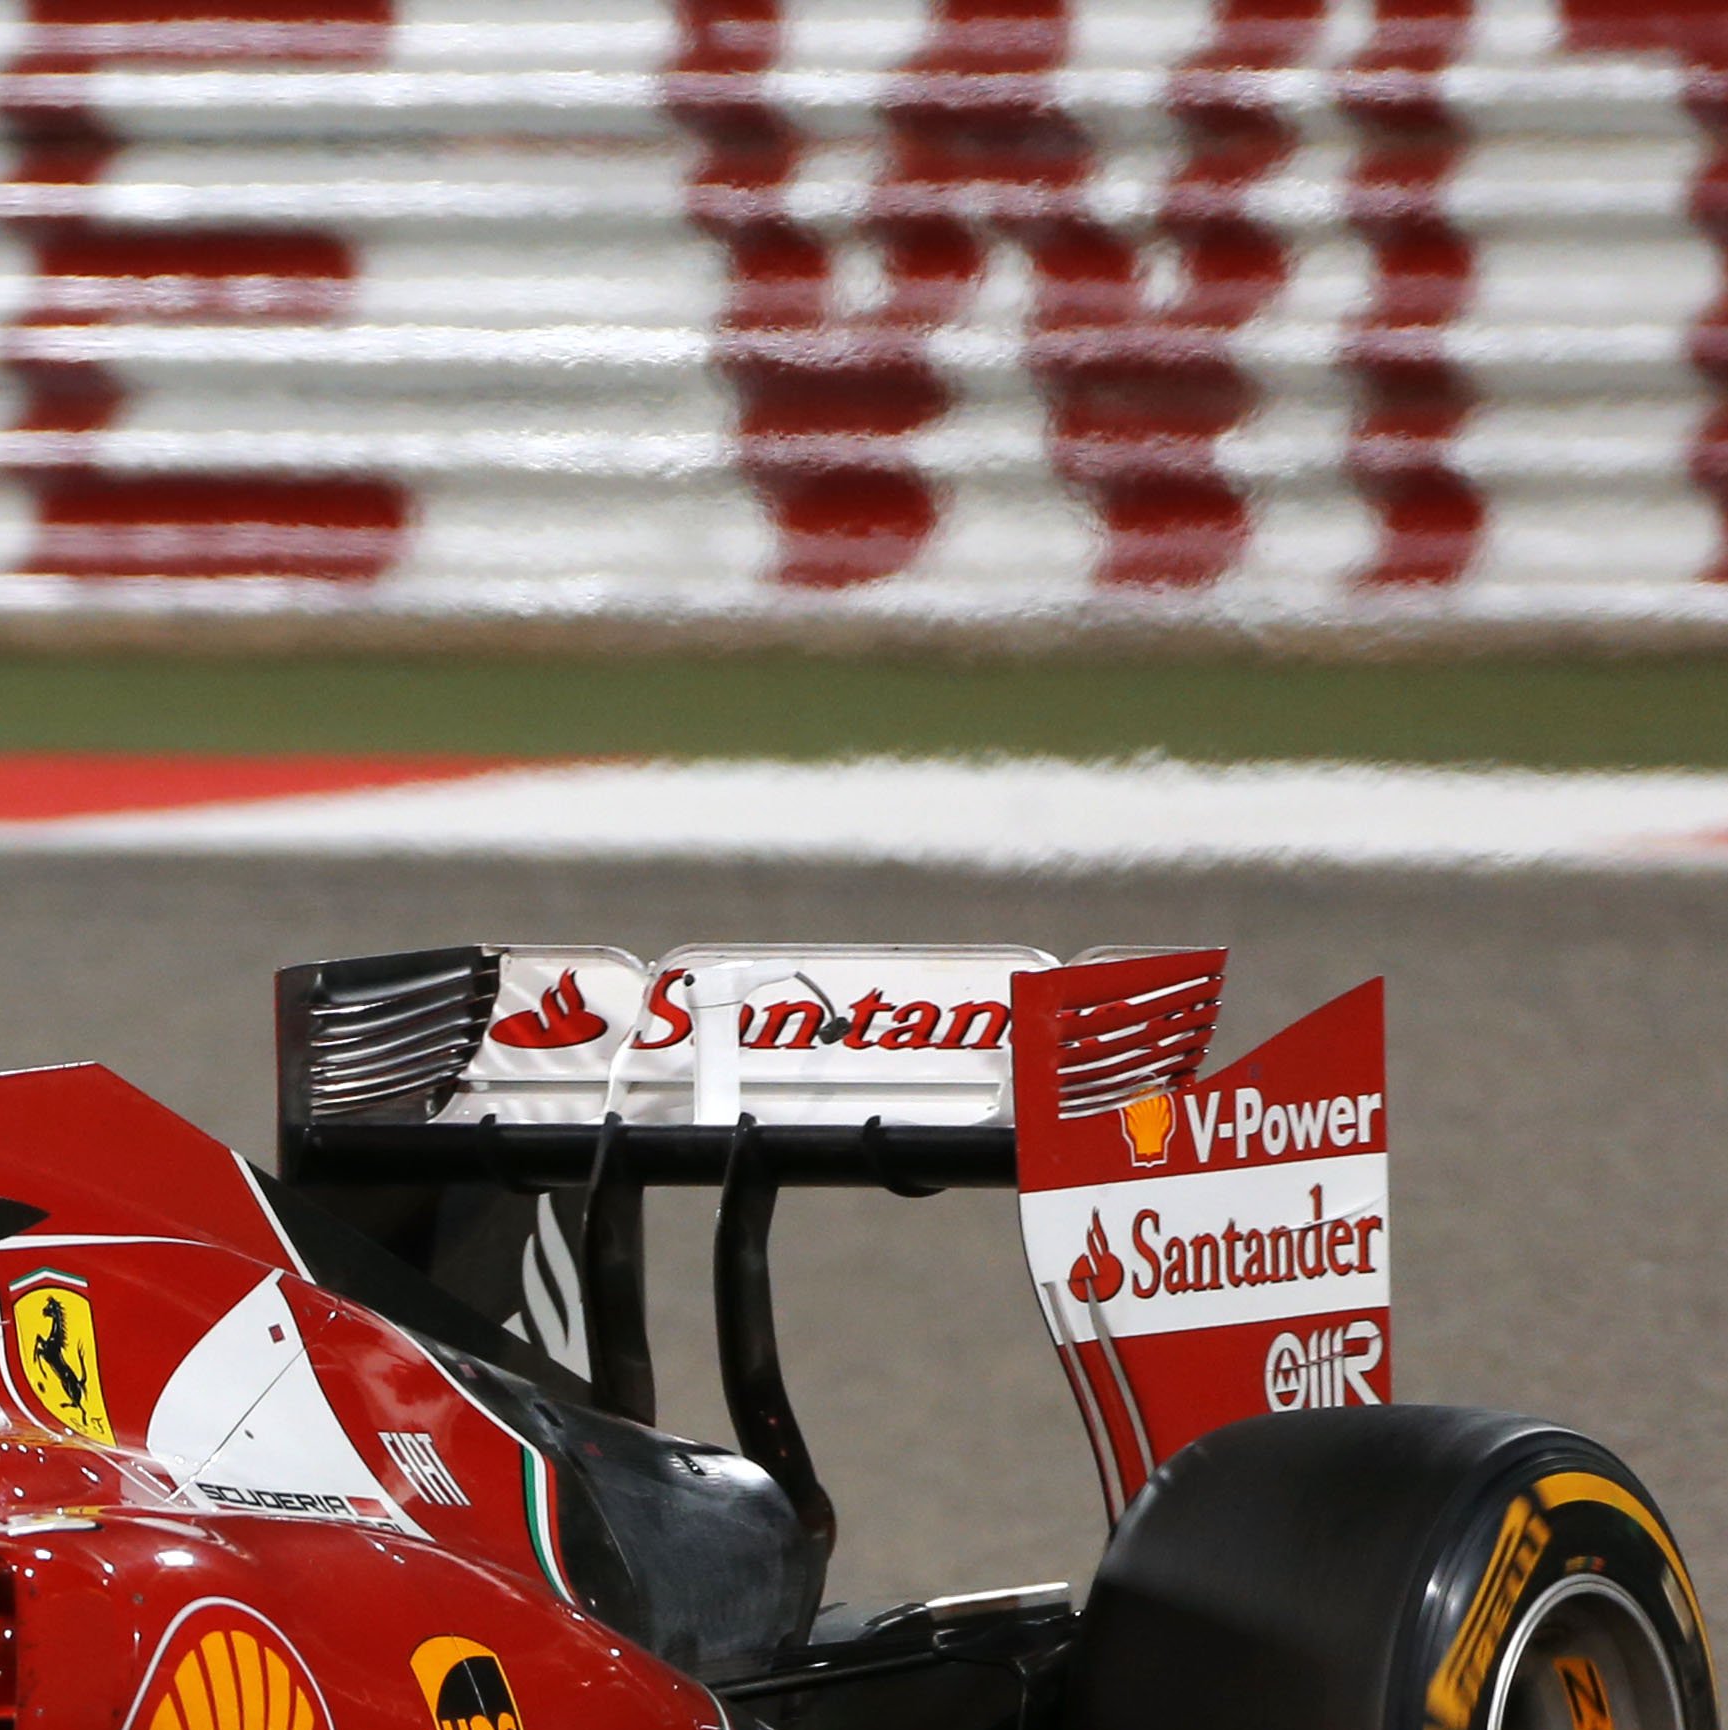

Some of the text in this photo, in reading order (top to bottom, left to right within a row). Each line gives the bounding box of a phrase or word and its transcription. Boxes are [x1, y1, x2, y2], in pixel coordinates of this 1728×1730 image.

[1184, 1087, 1383, 1164] V-Power
[1131, 1183, 1384, 1299] Santander
[195, 1482, 355, 1515] SCUDERIA
[377, 1431, 472, 1506] FIAT
